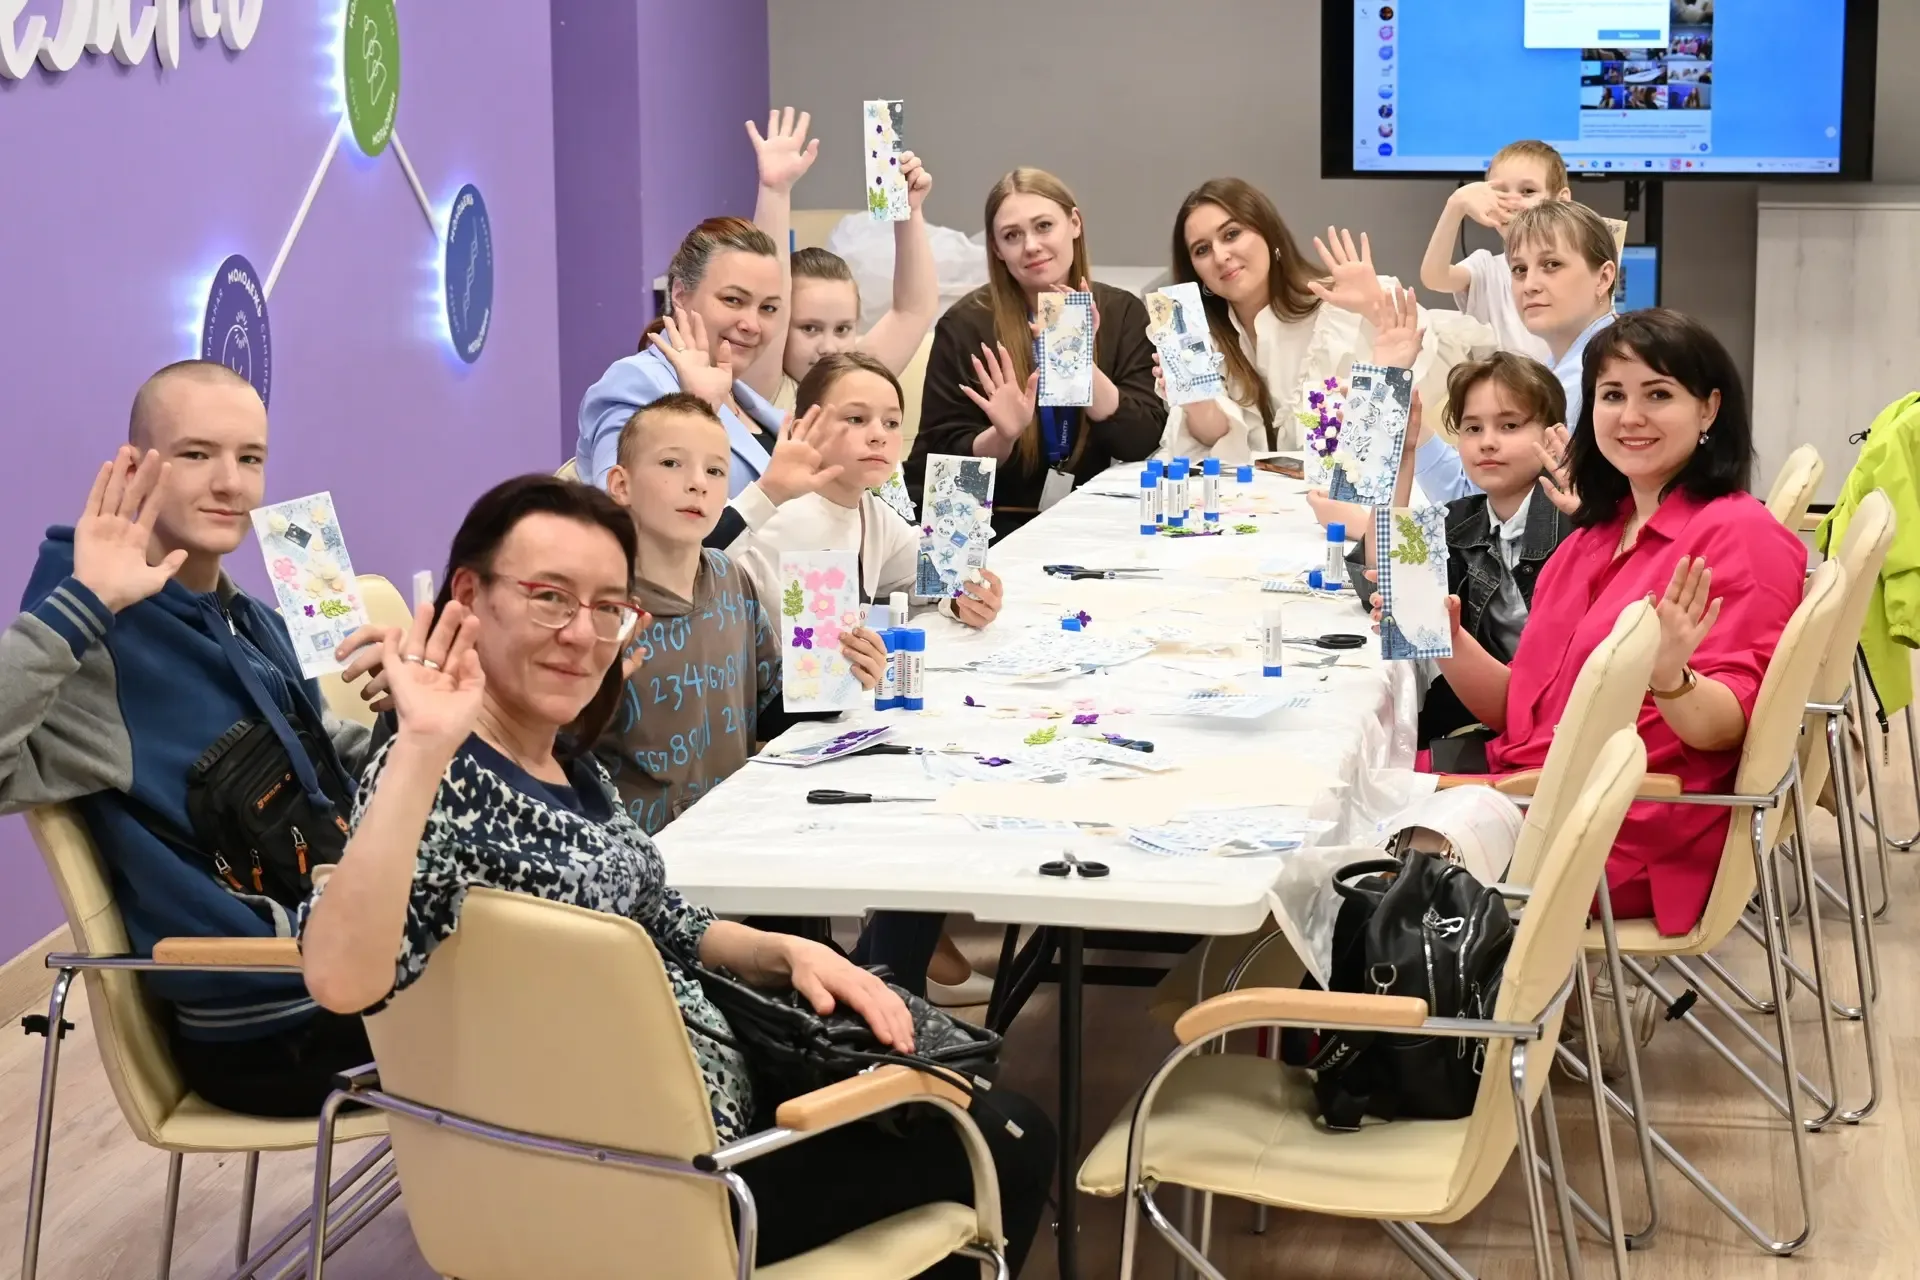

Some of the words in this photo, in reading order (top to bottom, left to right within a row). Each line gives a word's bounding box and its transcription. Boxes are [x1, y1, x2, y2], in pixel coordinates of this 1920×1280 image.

[206, 287, 223, 357] ИАЛЬНАЯ
[227, 268, 262, 318] МОЛОДЕЖЬ
[259, 322, 269, 404] САМОРЕАЛ
